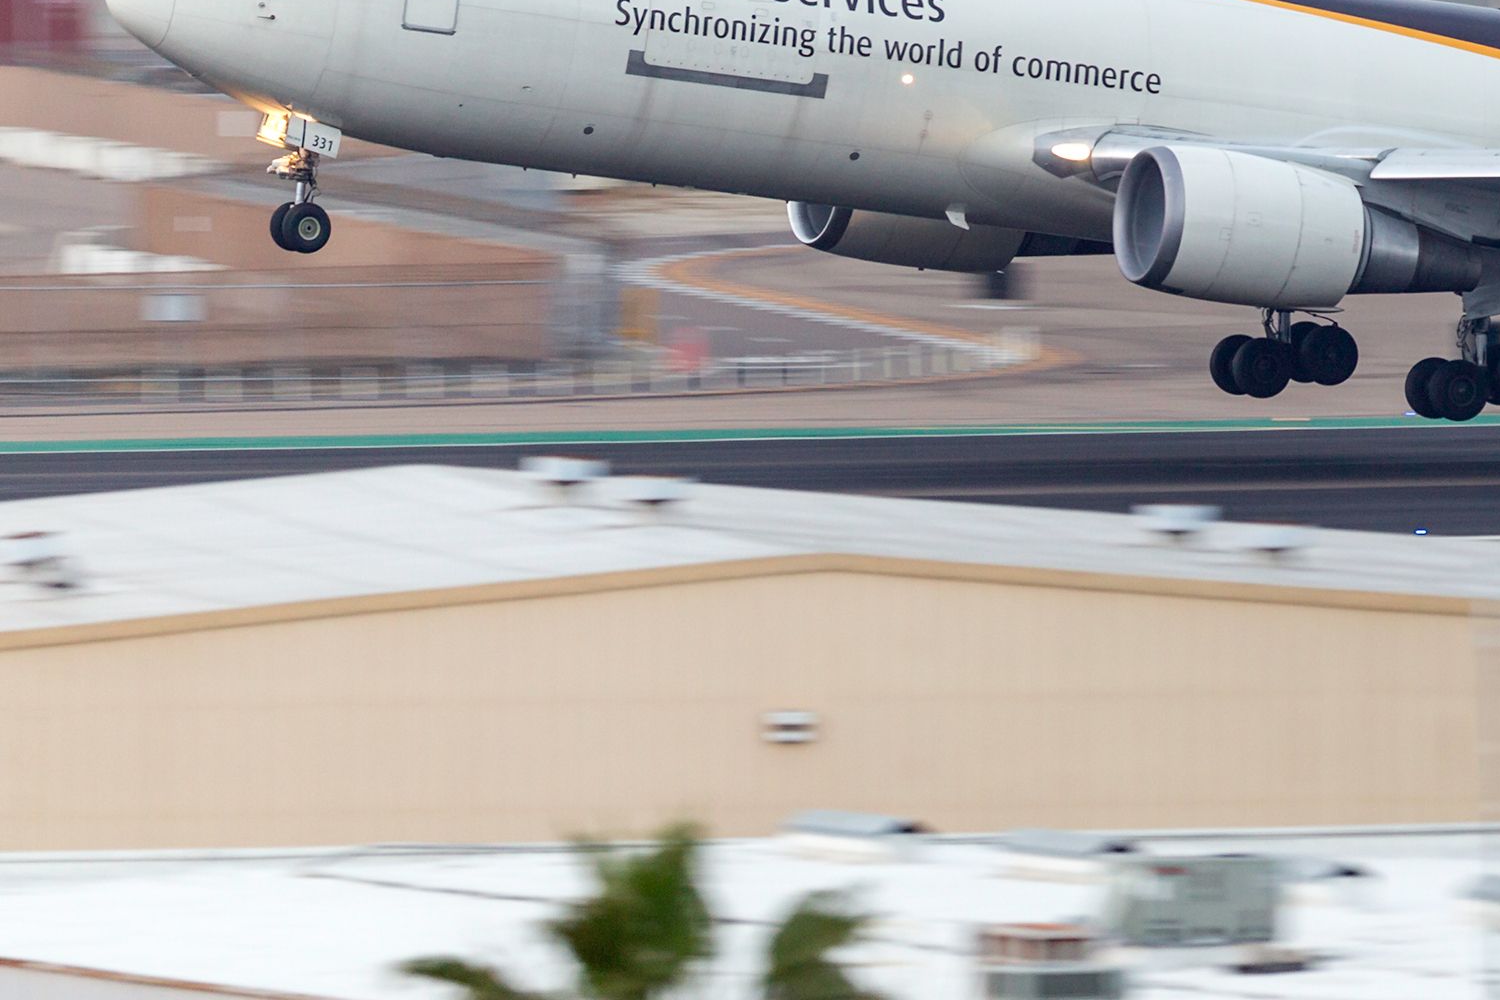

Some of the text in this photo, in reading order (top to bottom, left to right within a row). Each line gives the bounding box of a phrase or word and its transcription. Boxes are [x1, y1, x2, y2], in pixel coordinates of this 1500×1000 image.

[828, 26, 872, 57] the
[884, 39, 963, 69] world
[974, 45, 1002, 73] of
[1012, 55, 1161, 94] commerce
[312, 135, 333, 151] 331
